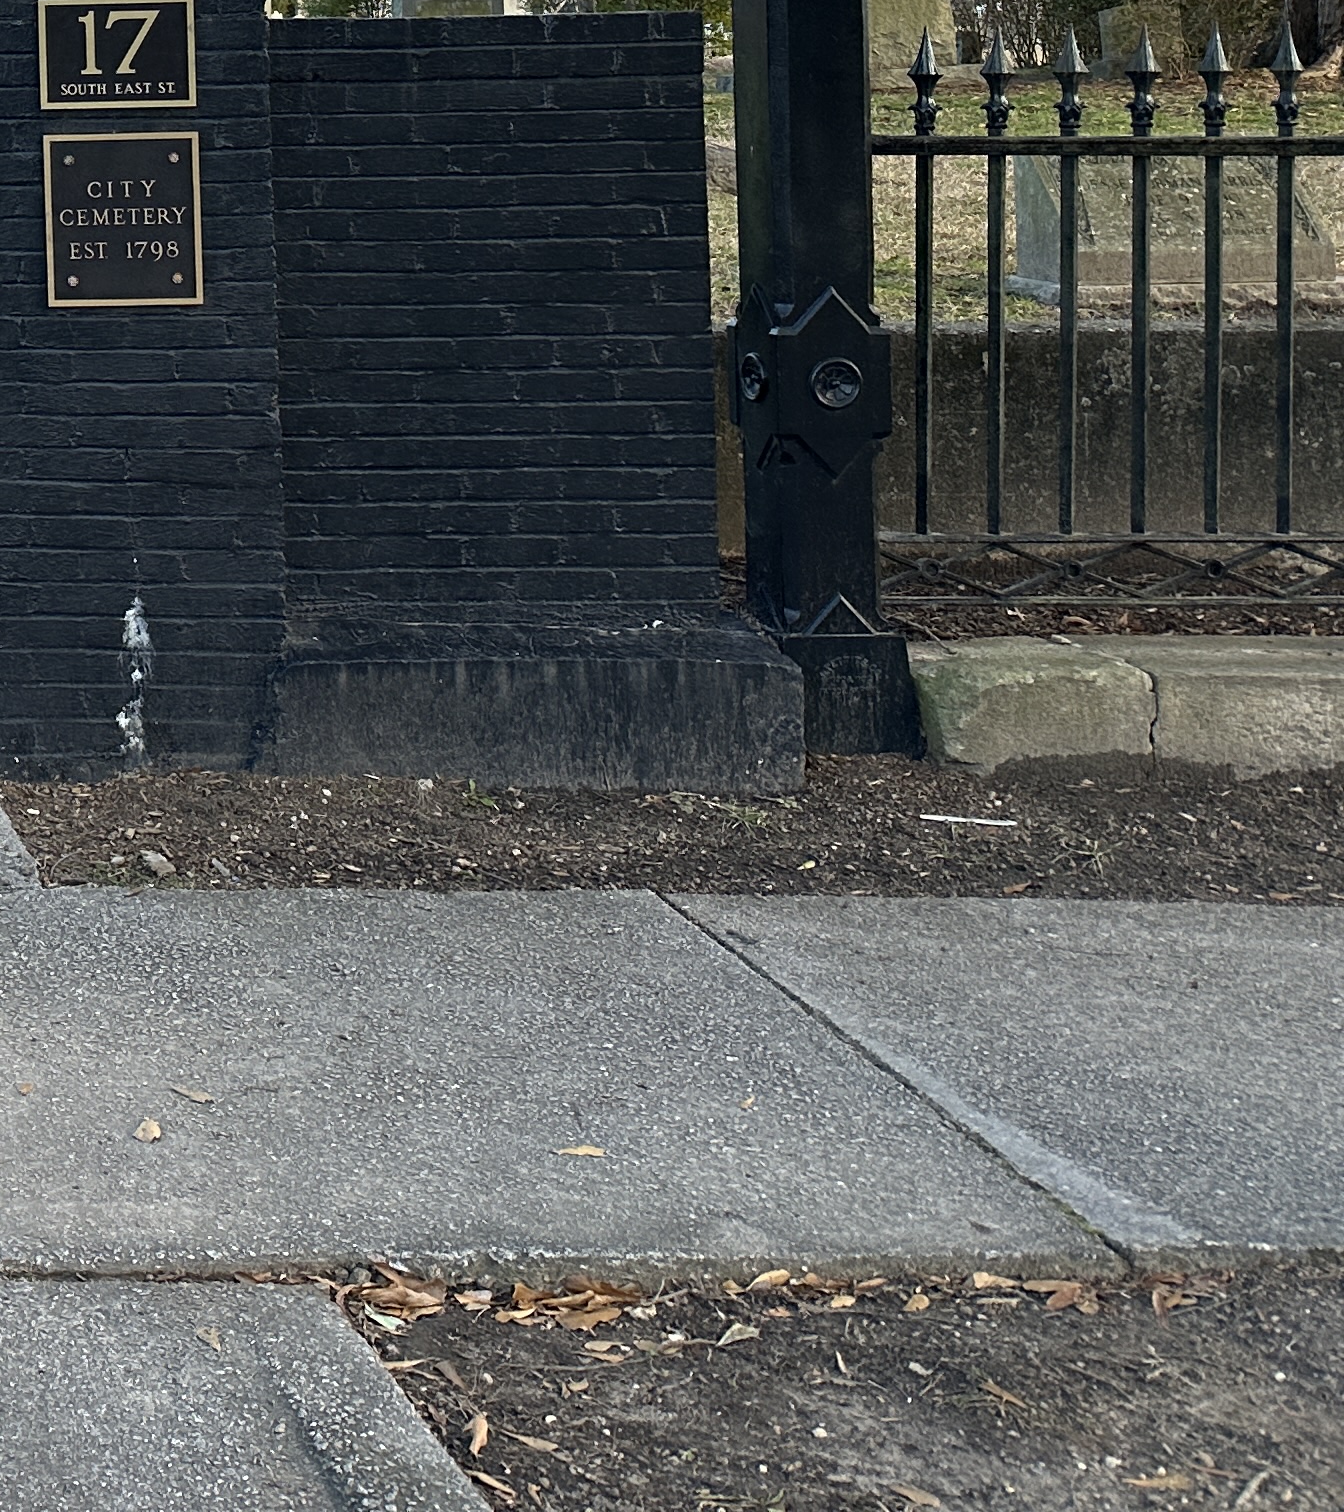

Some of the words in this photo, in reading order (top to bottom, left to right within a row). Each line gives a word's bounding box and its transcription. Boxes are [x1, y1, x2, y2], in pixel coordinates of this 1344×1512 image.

[78, 10, 161, 75] 17
[60, 83, 107, 96] SOUTH
[115, 82, 152, 95] EAST
[87, 180, 156, 198] CITY
[59, 207, 187, 227] CEMETERY
[126, 241, 179, 262] 1798
